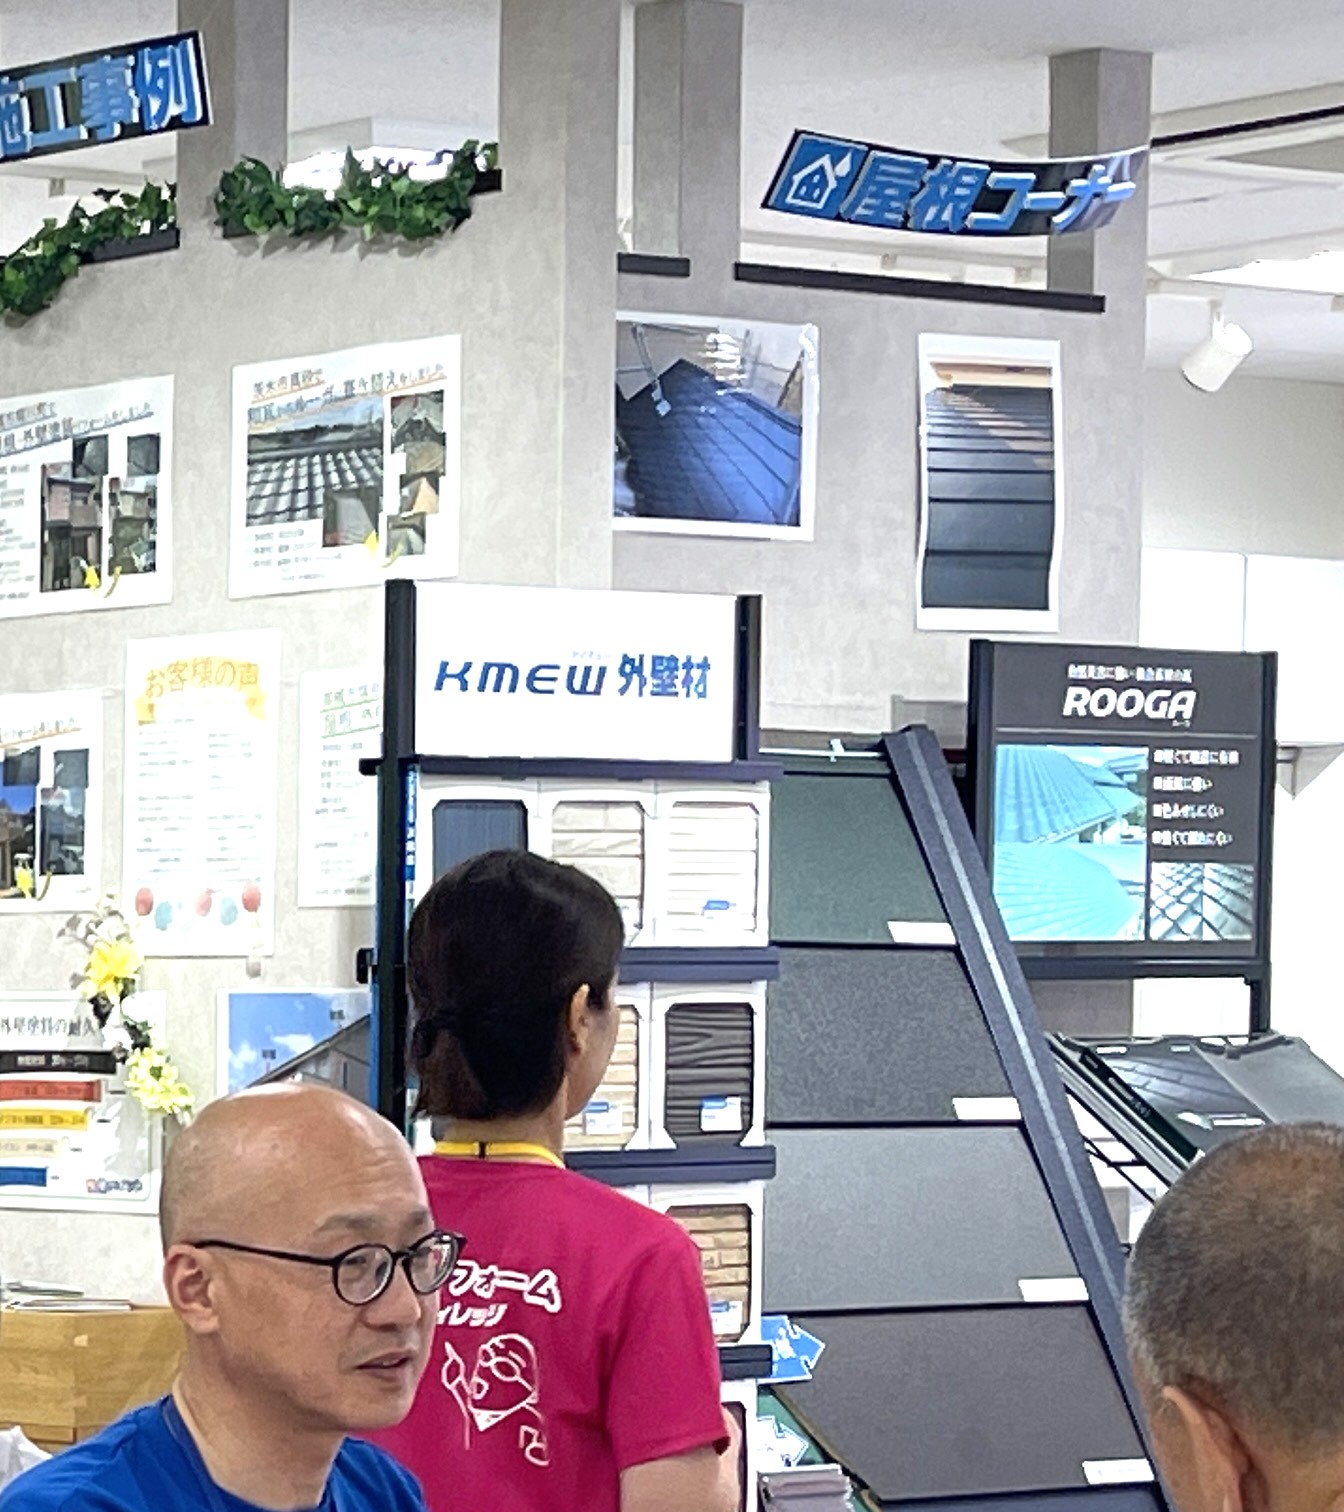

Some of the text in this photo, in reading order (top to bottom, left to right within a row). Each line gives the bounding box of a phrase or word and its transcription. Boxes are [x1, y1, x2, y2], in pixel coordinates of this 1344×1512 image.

[145, 657, 259, 699] お客様の声
[434, 653, 711, 699] KMEW 外壁材
[1062, 685, 1197, 720] ROOGA
[449, 1259, 562, 1313] フォーム
[436, 1302, 508, 1327] ィレッジ
